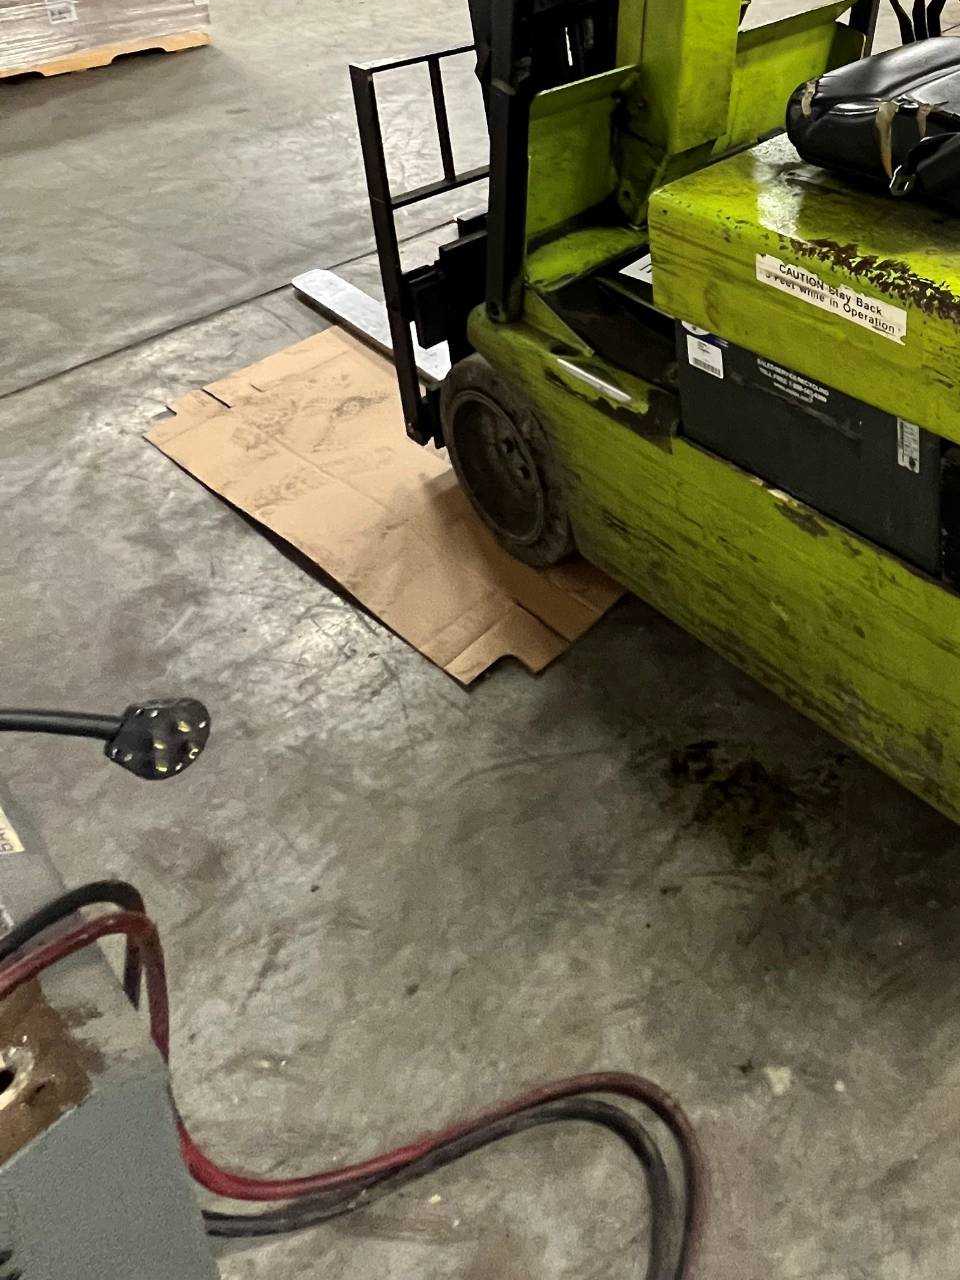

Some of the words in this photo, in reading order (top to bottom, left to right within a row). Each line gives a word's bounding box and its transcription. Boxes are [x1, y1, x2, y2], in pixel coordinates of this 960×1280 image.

[779, 264, 824, 290] CAUTION
[856, 297, 881, 315] Back
[830, 297, 839, 309] in
[843, 303, 895, 334] Operation
